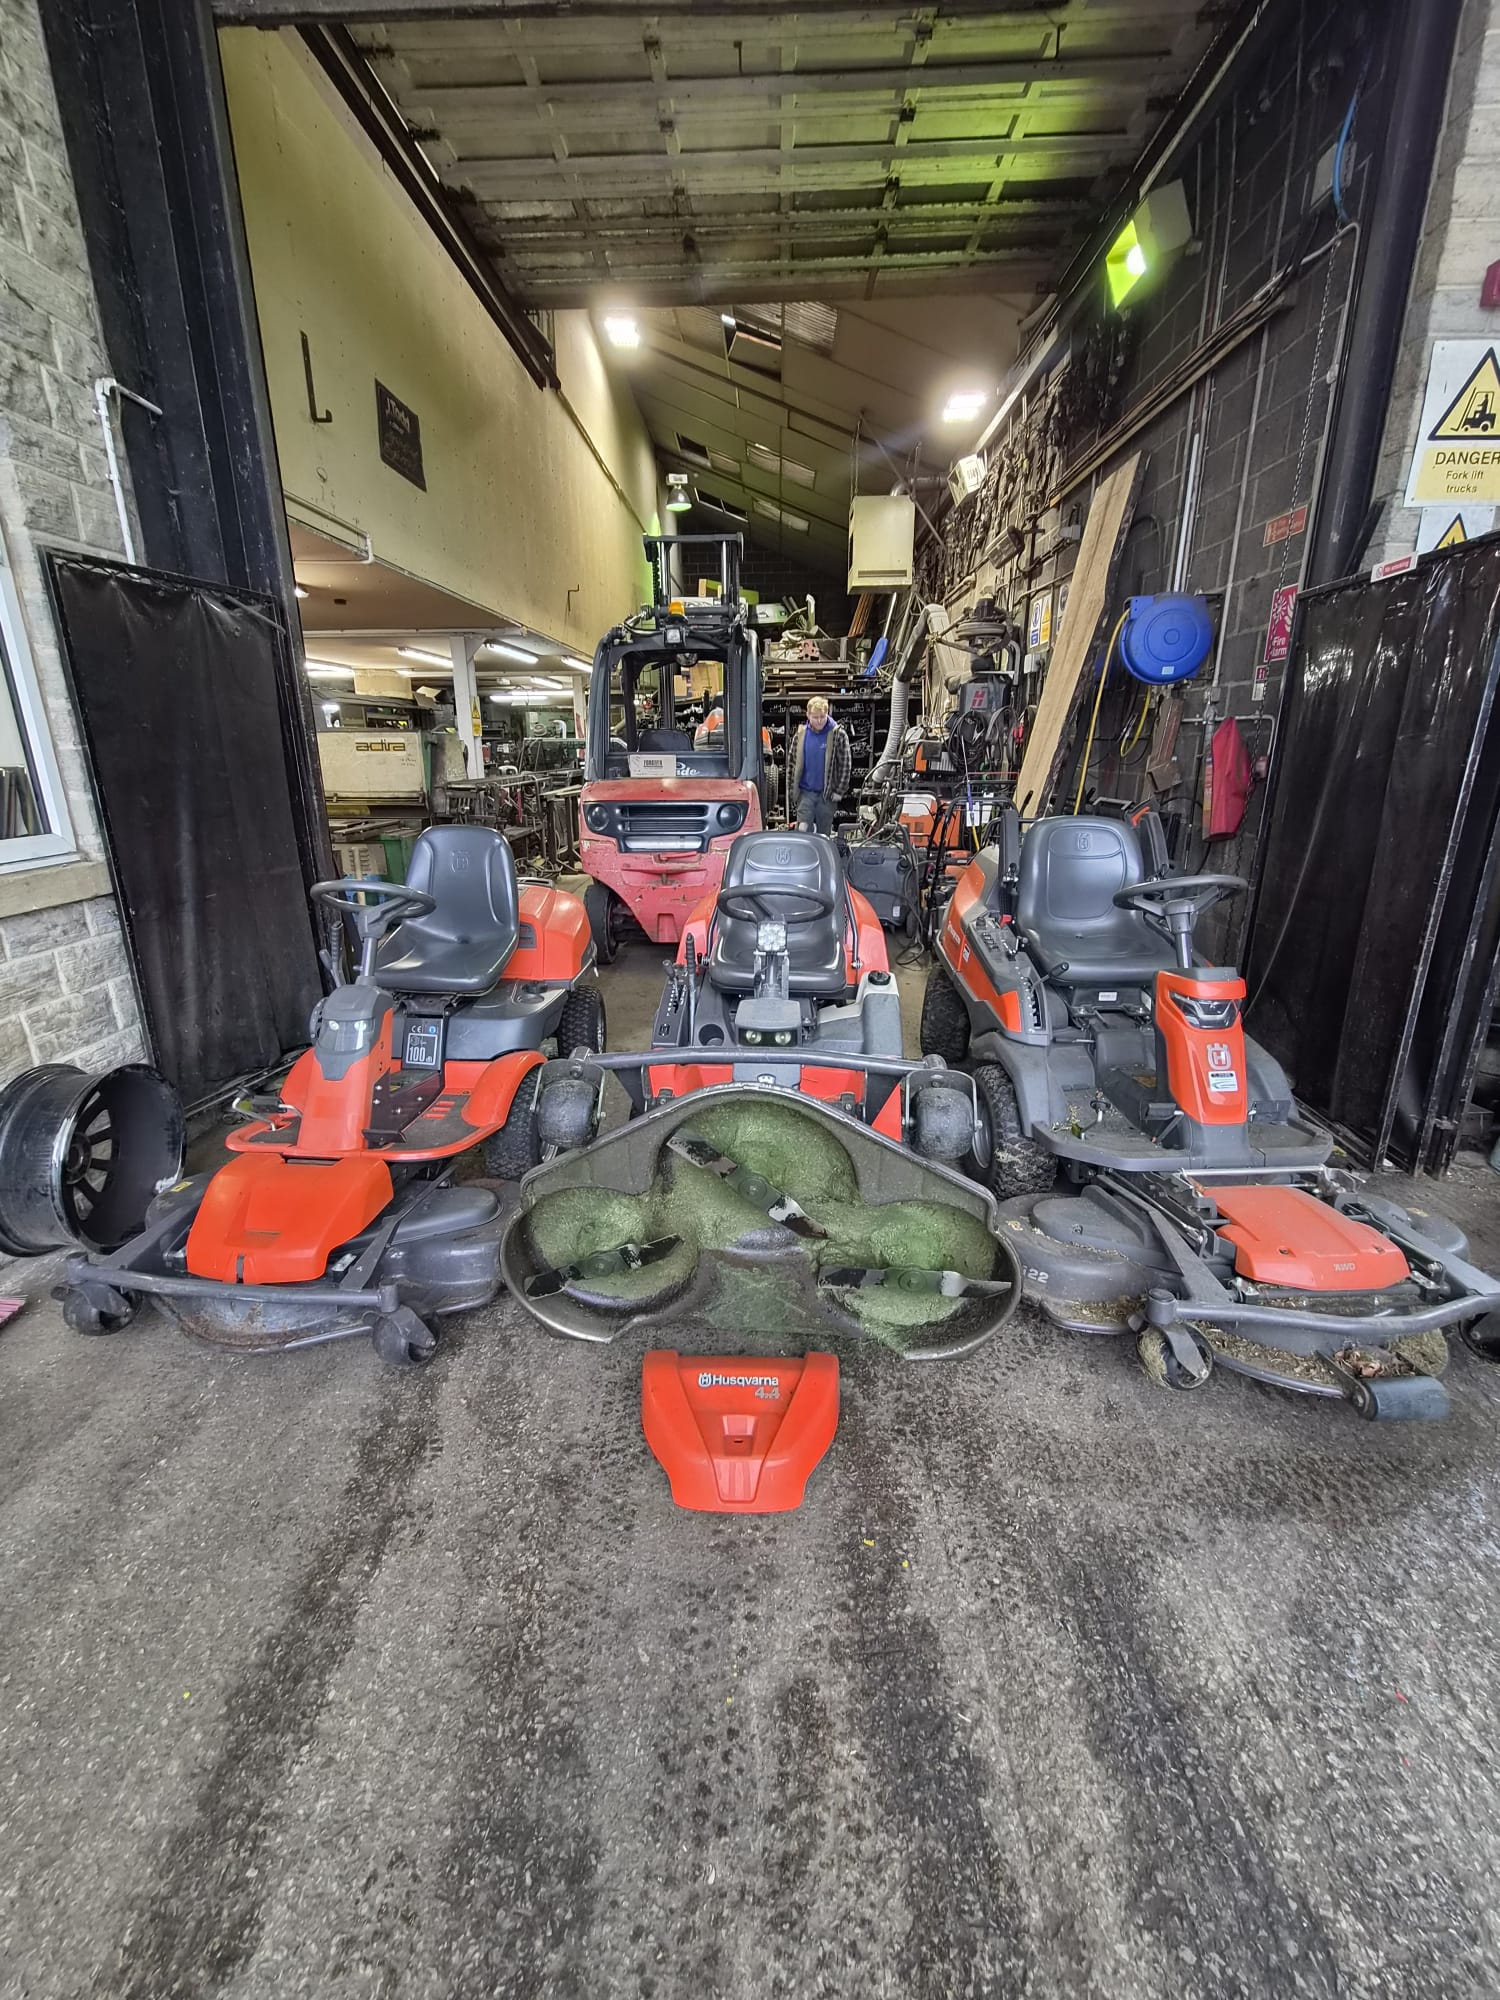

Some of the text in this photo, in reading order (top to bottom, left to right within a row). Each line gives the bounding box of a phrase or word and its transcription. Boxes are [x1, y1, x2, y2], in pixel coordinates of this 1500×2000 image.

[1435, 451, 1500, 465] DANGER
[1446, 470, 1484, 480] Fork lift
[1446, 484, 1477, 493] trucks
[1272, 636, 1286, 646] Fire
[355, 738, 406, 752] adira
[409, 1046, 426, 1062] 100
[712, 1374, 779, 1387] Husqvarna
